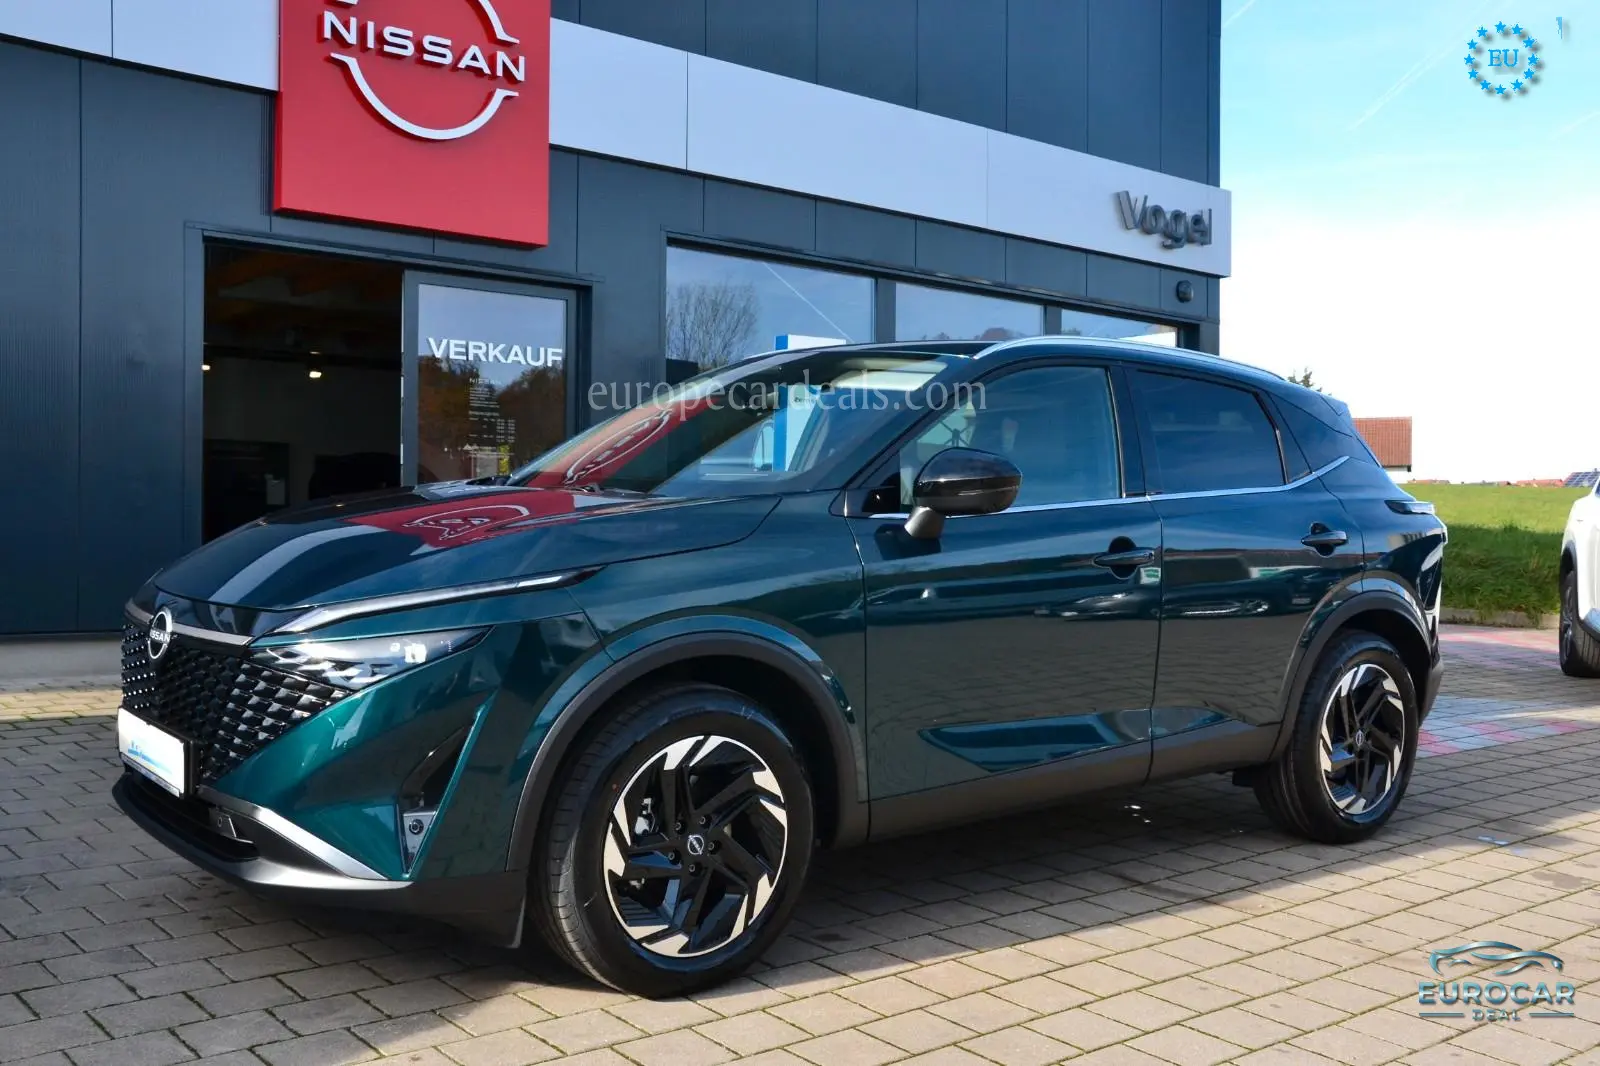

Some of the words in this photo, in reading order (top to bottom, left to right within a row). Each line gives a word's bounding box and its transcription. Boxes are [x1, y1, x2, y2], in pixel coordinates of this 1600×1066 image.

[322, 10, 526, 82] NISSAN
[1114, 190, 1213, 249] Vogel
[428, 337, 563, 367] VERKAUF
